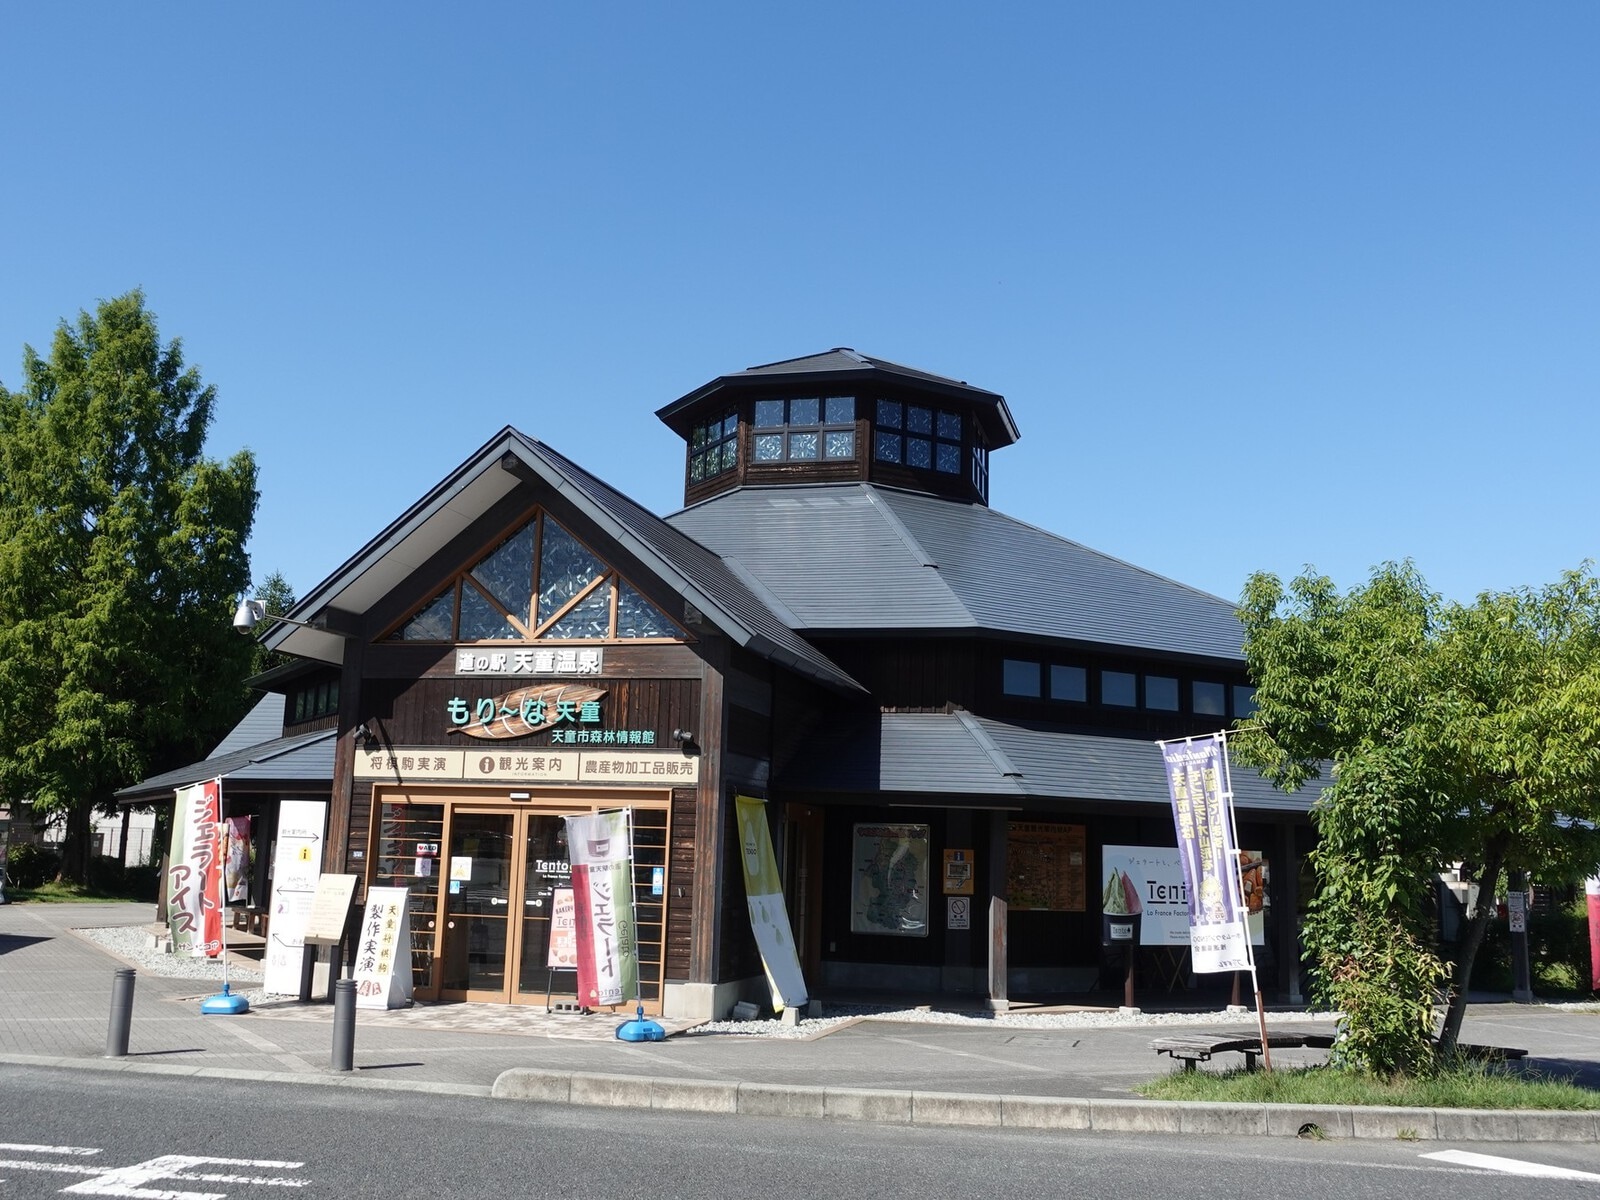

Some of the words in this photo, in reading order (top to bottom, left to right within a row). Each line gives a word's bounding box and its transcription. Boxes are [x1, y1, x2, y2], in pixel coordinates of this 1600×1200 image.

[458, 652, 506, 673] 道の駅
[512, 649, 599, 674] 天童温泉
[551, 729, 655, 745] 天童市森林情報館
[370, 756, 447, 771] 将棋駒実演
[499, 757, 562, 772] 観光案内
[584, 760, 694, 776] 農産物加工品販売
[190, 793, 215, 916] ジェラート
[535, 859, 569, 872] Tento
[169, 865, 197, 933] アイス
[358, 903, 385, 973] 製作実演
[376, 904, 397, 974] 天童将棋駒
